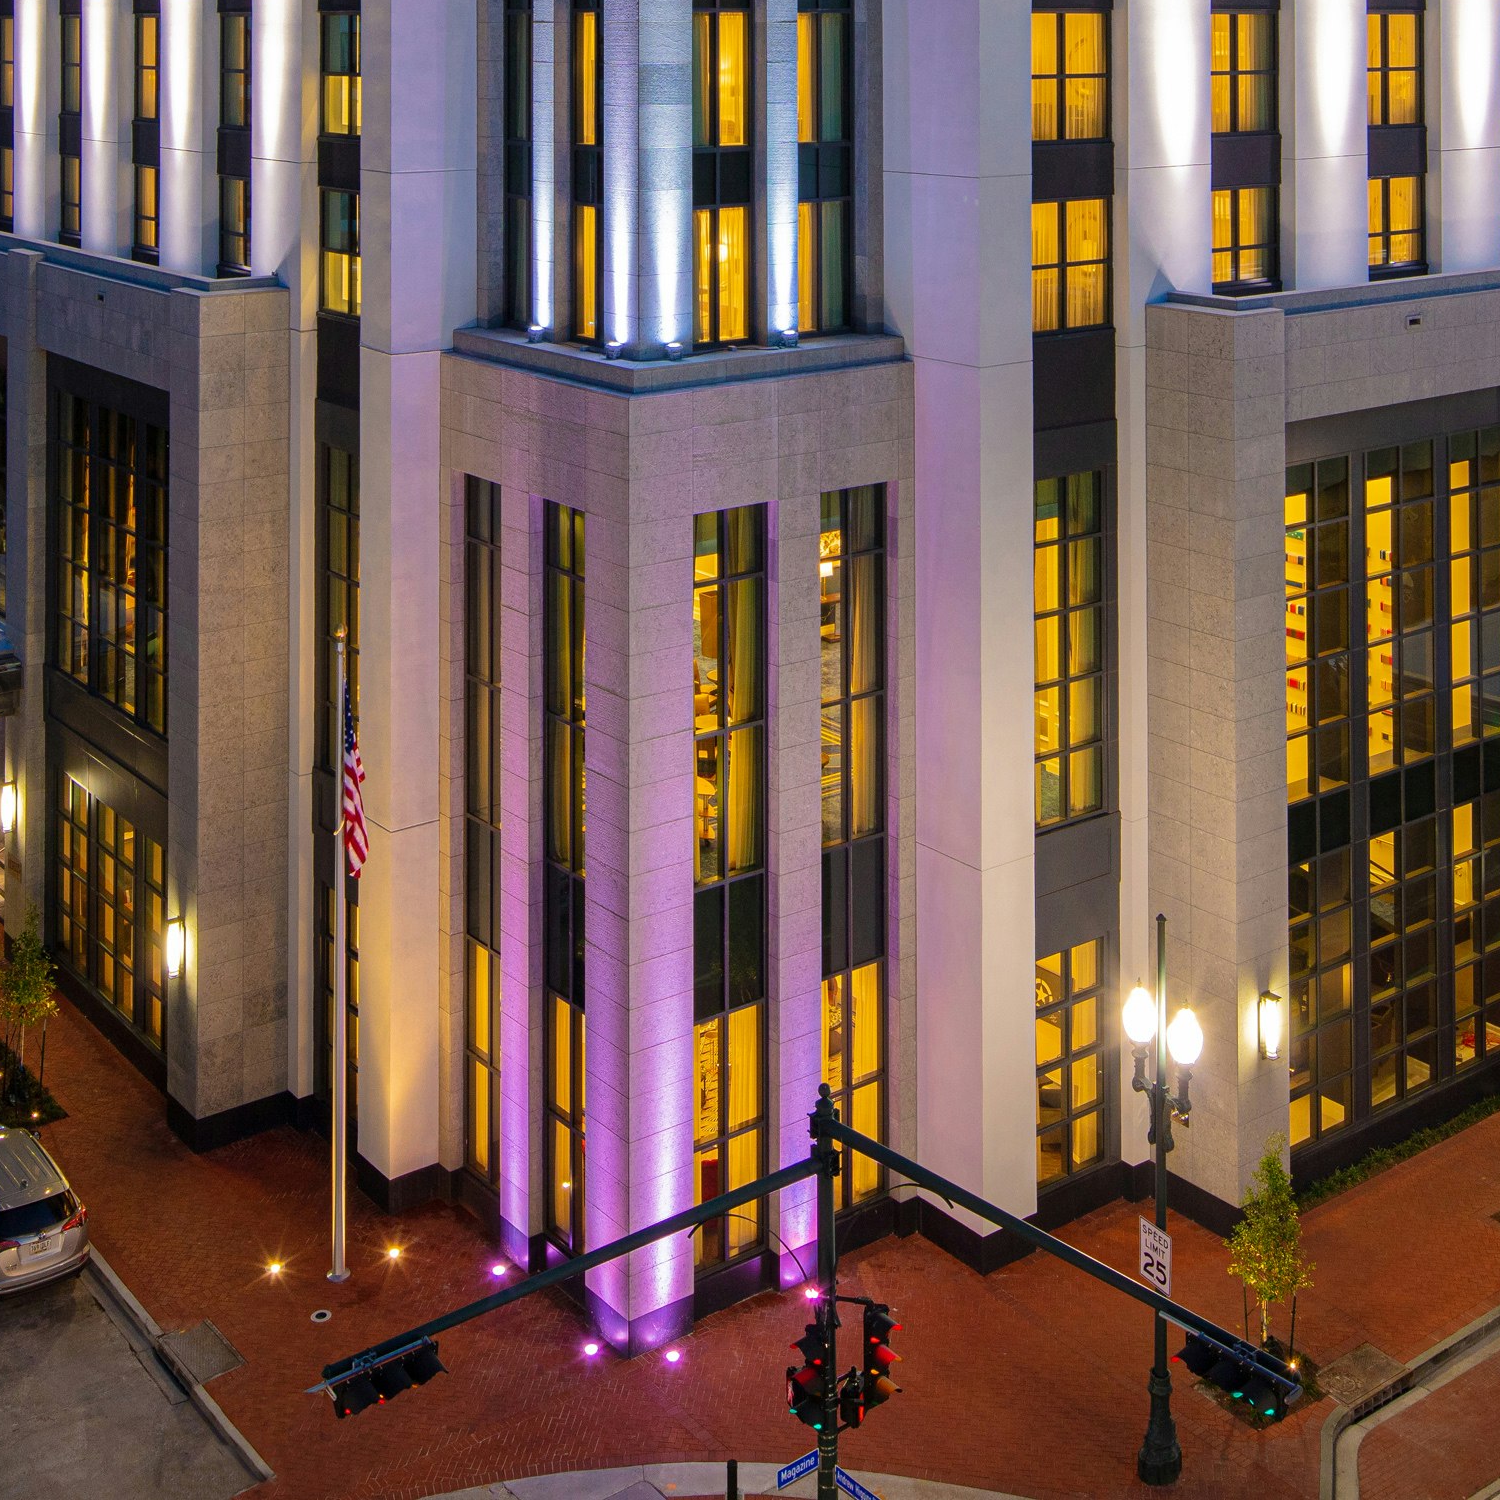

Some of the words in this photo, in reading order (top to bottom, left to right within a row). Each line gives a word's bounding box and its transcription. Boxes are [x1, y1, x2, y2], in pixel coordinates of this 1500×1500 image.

[1142, 1224, 1169, 1250] SPEED
[1145, 1238, 1166, 1260] LIMIT
[1143, 1251, 1167, 1286] 25
[780, 1456, 815, 1483] Magazine
